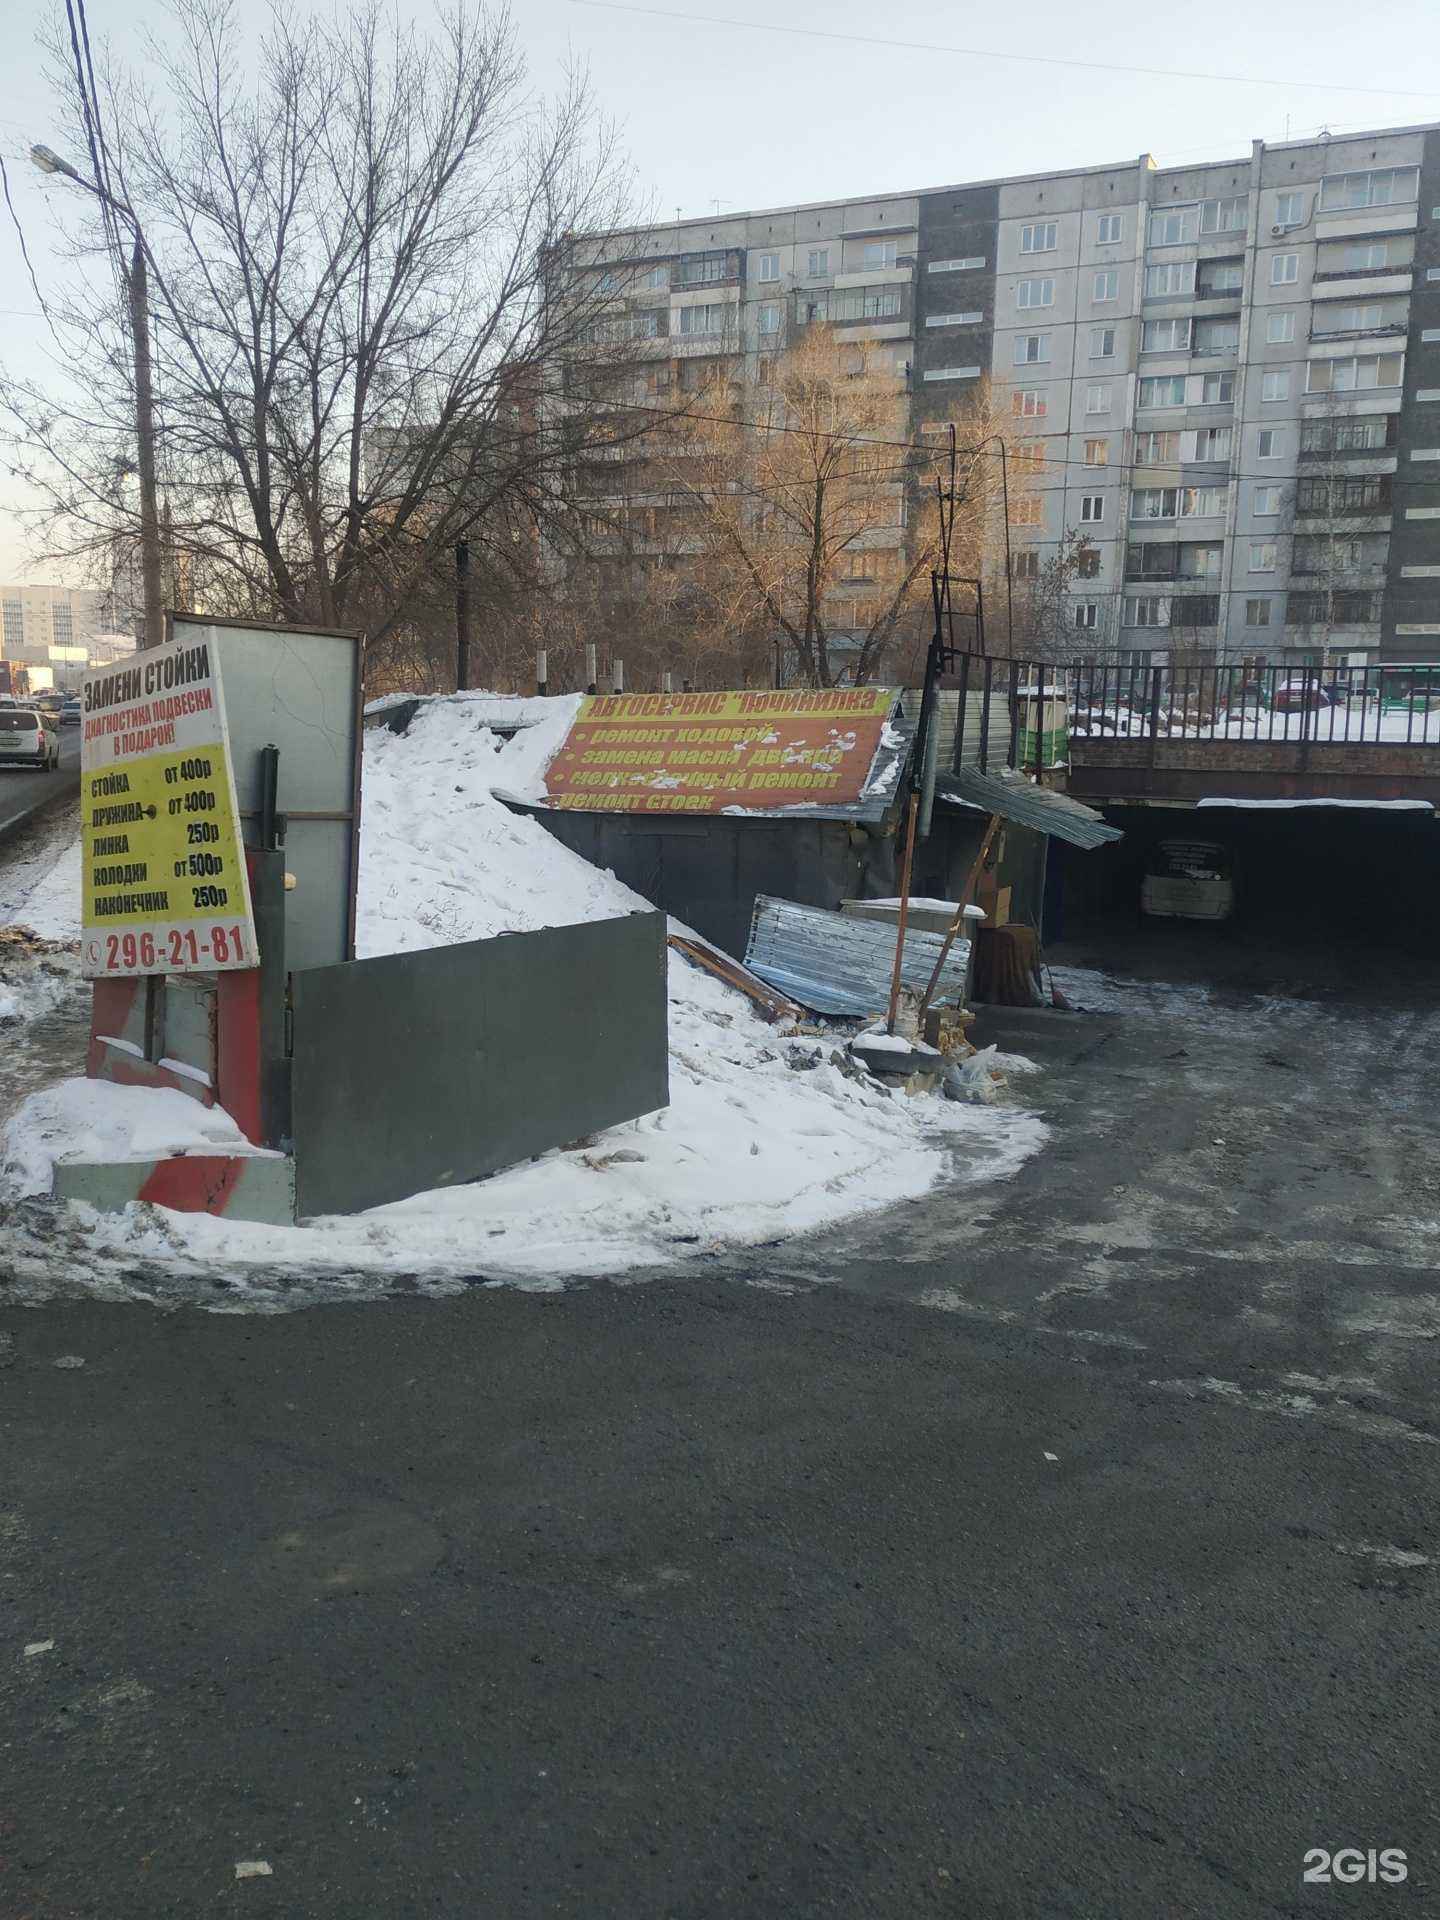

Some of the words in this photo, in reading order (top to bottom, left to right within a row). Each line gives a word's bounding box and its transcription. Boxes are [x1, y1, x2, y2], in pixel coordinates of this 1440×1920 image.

[84, 667, 141, 712] ЗАМЕНИ
[145, 644, 210, 695] СТОЙКИ
[84, 704, 152, 741] ДИАГНОСТИКА
[152, 688, 213, 722] ПОДВЕСКИ
[113, 736, 121, 755] В
[122, 724, 175, 754] ПОДАРОК!
[91, 772, 130, 798] СТОЙКА
[92, 802, 143, 828] ПРУЖИНА
[94, 863, 147, 886] КОЛОДКИ
[94, 891, 169, 916] НАКОНЕЧНИК
[106, 925, 244, 970] 296-21-81
